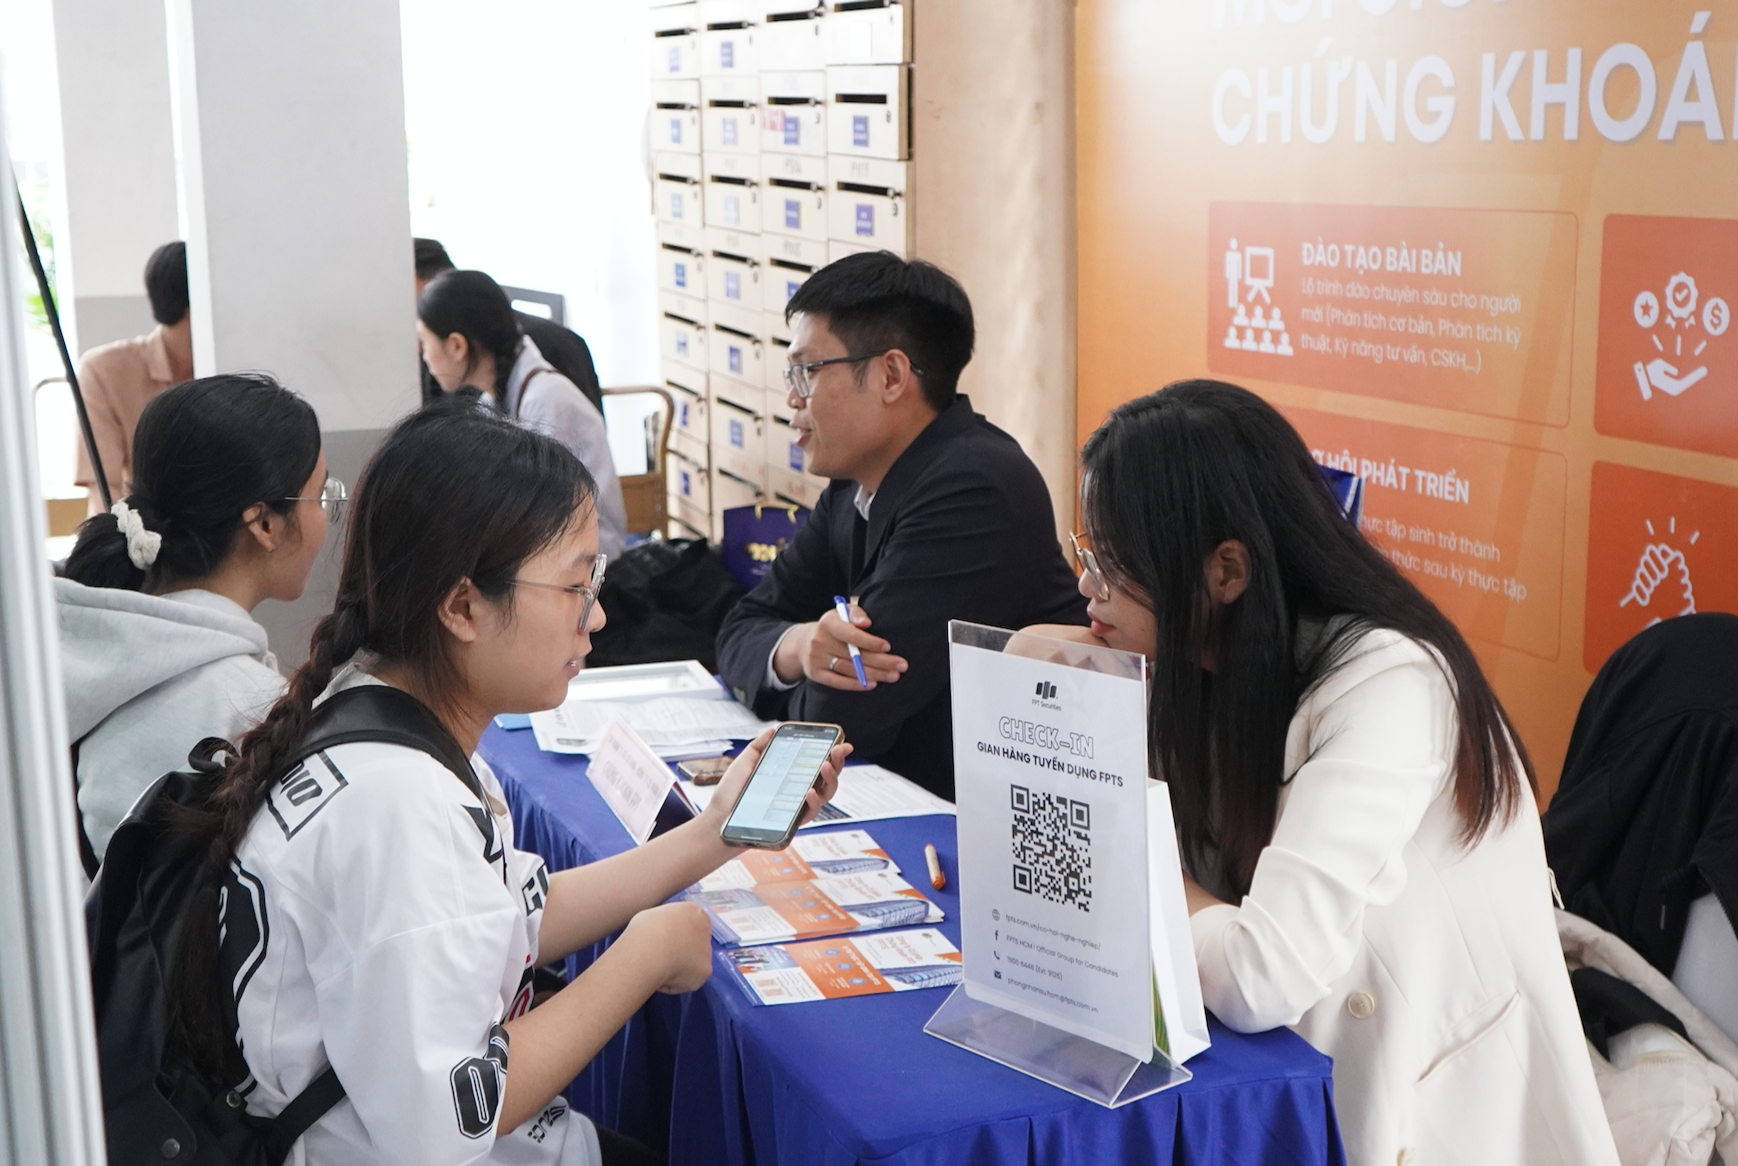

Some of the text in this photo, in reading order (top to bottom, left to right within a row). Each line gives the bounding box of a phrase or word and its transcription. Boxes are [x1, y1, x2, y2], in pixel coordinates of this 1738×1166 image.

[1211, 11, 1738, 145] CHỨNG KHOÁ
[1302, 237, 1462, 276] ĐÀO TẠO BÀI BẢN
[1301, 278, 1315, 296] Lộ
[1316, 279, 1343, 296] trình
[1372, 284, 1420, 306] chuyên
[1422, 287, 1448, 306] sâu
[1450, 291, 1477, 309] cho
[1480, 293, 1522, 316] người
[1301, 303, 1522, 350] mới (Phân tích cơ bản, Phân tích kỹ
[1351, 340, 1384, 364] năng
[1386, 344, 1400, 361] tư
[1403, 344, 1428, 367] vấn,
[1361, 458, 1411, 491] PHÁT
[1414, 467, 1470, 504] TRIỂN
[1385, 517, 1407, 542] tập
[1409, 523, 1435, 545] sinh
[1438, 530, 1458, 551] trở
[1460, 537, 1501, 562] thành
[1391, 549, 1421, 572] thức
[1424, 559, 1448, 579] sau
[1468, 569, 1500, 592] thực
[1504, 578, 1528, 602] tập
[1040, 700, 1062, 712] Securities
[998, 715, 1095, 760] CHECK-IN
[977, 741, 1124, 788] GIAN HÀNG TUYỂN DỤNG FPTS
[1006, 935, 1019, 945] FPTS
[1019, 940, 1033, 950] HCM
[1036, 945, 1056, 957] Official
[1057, 951, 1075, 964] Group
[1084, 961, 1119, 979] Candidates
